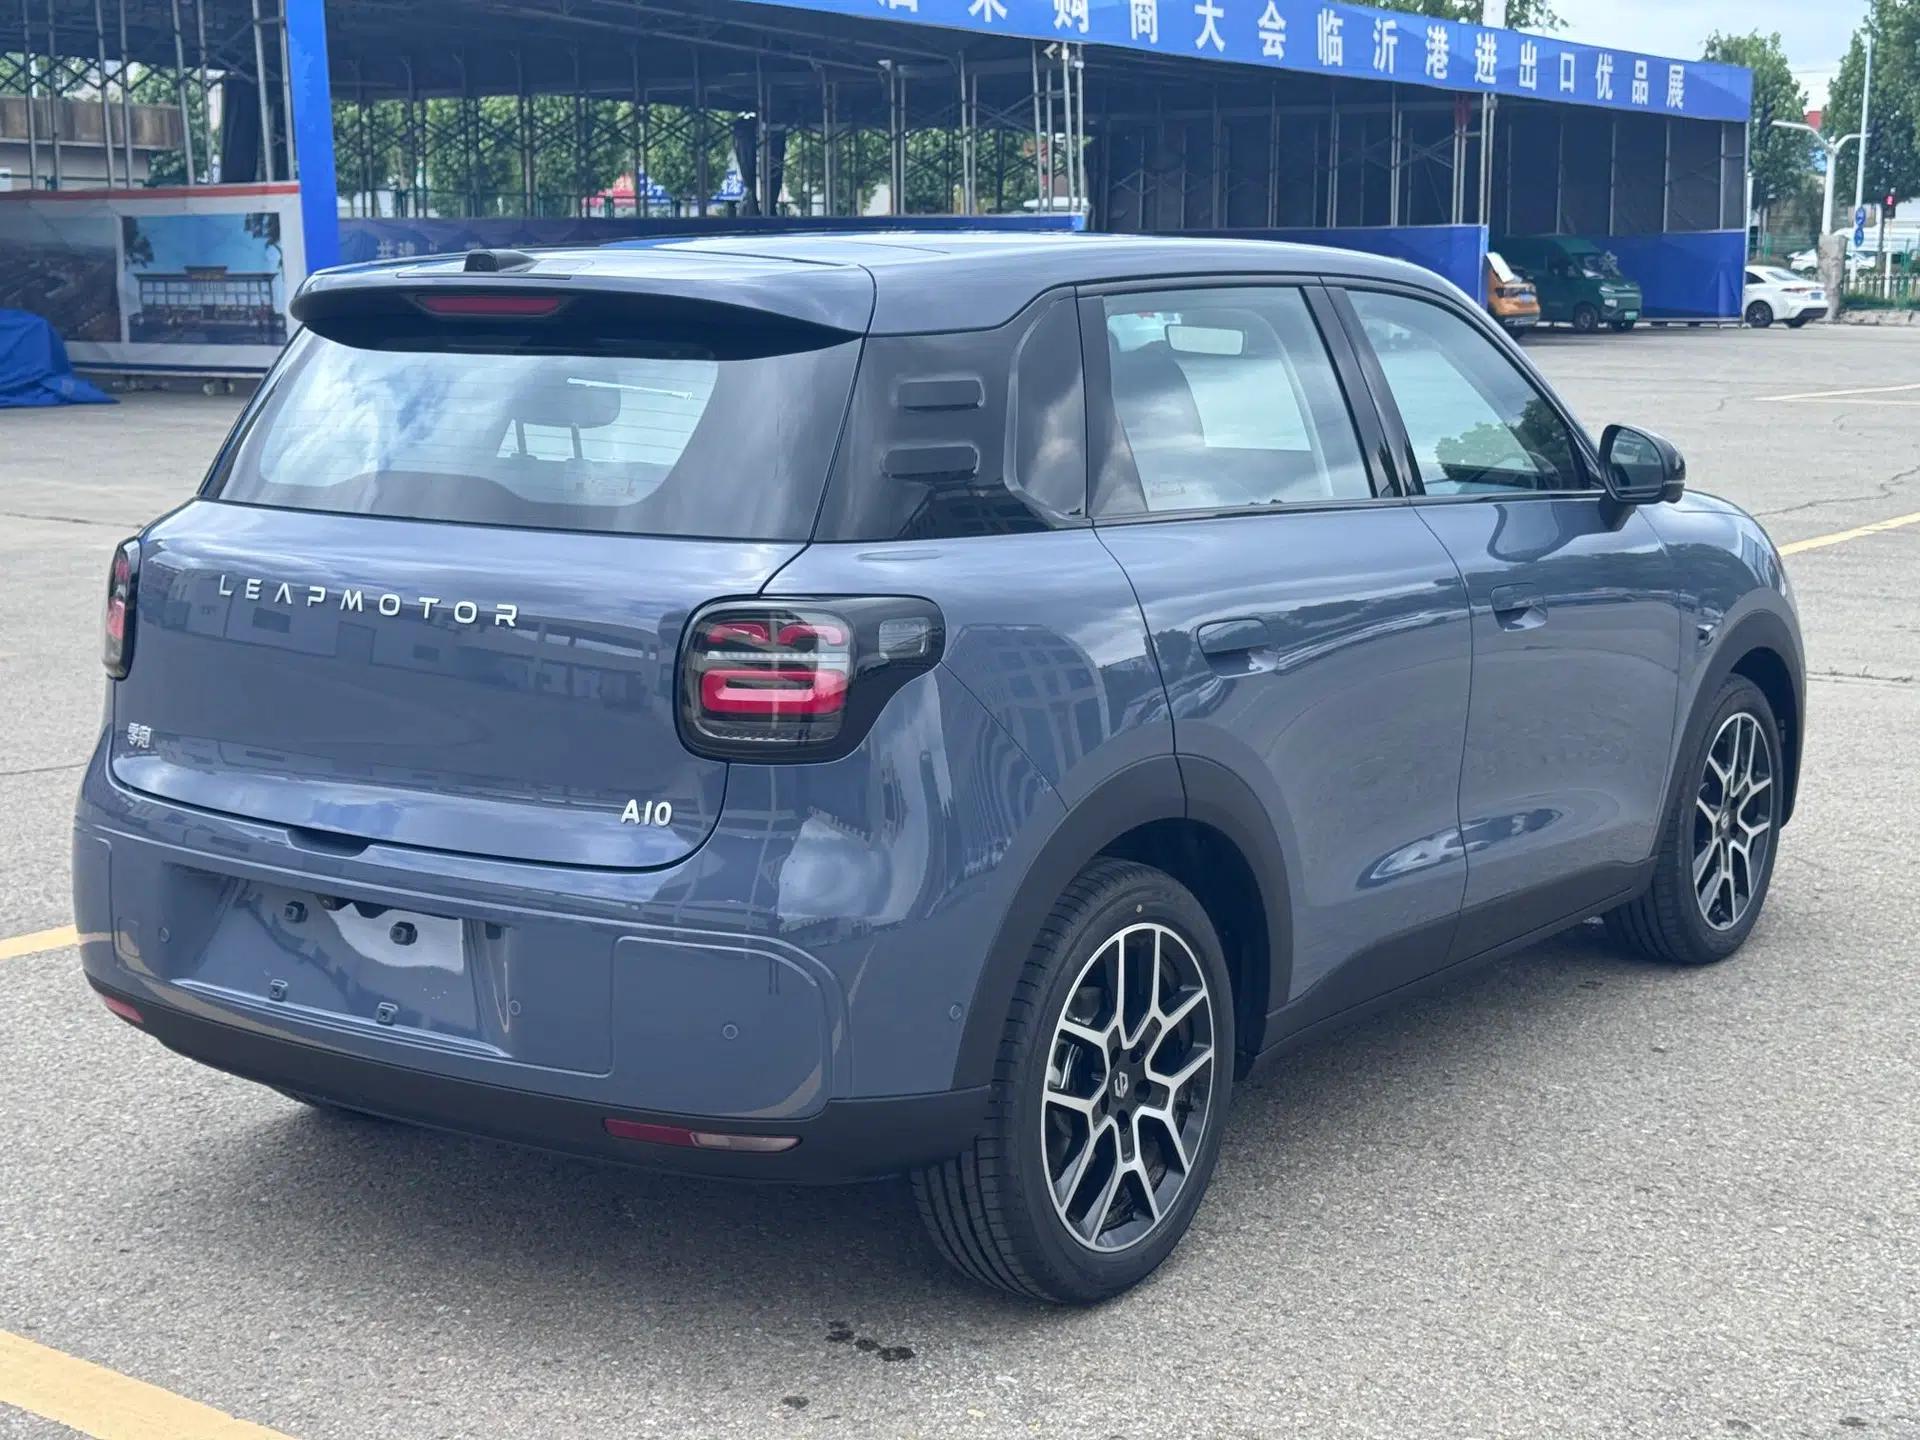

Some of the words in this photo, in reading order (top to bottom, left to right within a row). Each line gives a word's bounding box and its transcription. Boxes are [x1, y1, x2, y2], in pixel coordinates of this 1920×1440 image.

[878, 0, 1685, 109] 购商大会临沂港进出口优品展
[218, 574, 519, 628] LEAPMOTOR
[620, 799, 673, 827] A10
